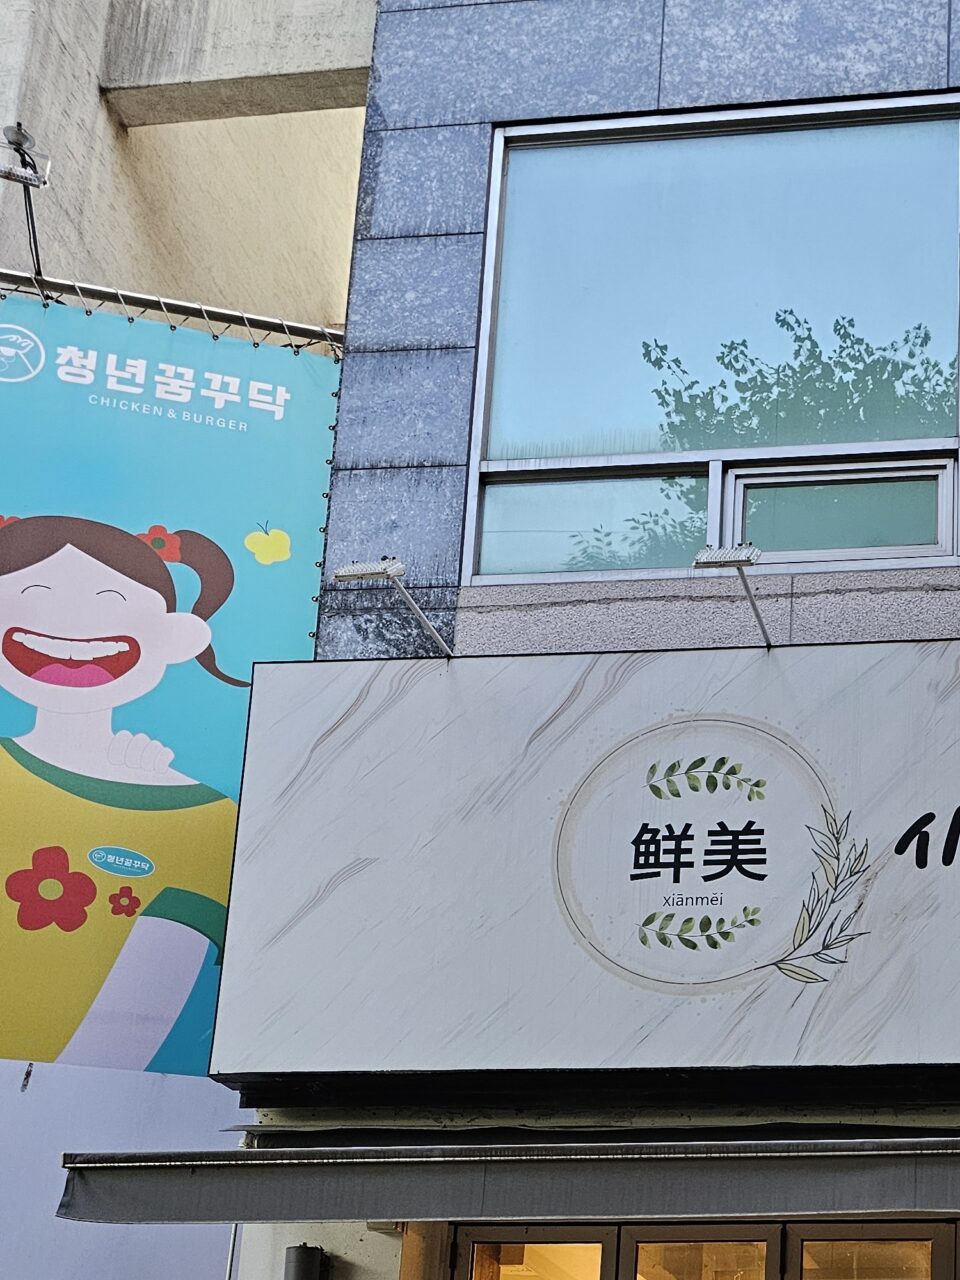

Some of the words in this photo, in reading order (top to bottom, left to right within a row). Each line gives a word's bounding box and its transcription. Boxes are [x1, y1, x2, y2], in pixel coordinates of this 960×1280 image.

[55, 345, 290, 421] 청년꿈꾸닭
[88, 394, 163, 417] CHICKEN
[166, 408, 178, 419] &
[181, 411, 249, 432] BURGER
[630, 820, 768, 884] 鲜美
[662, 892, 724, 907] xiānměi
